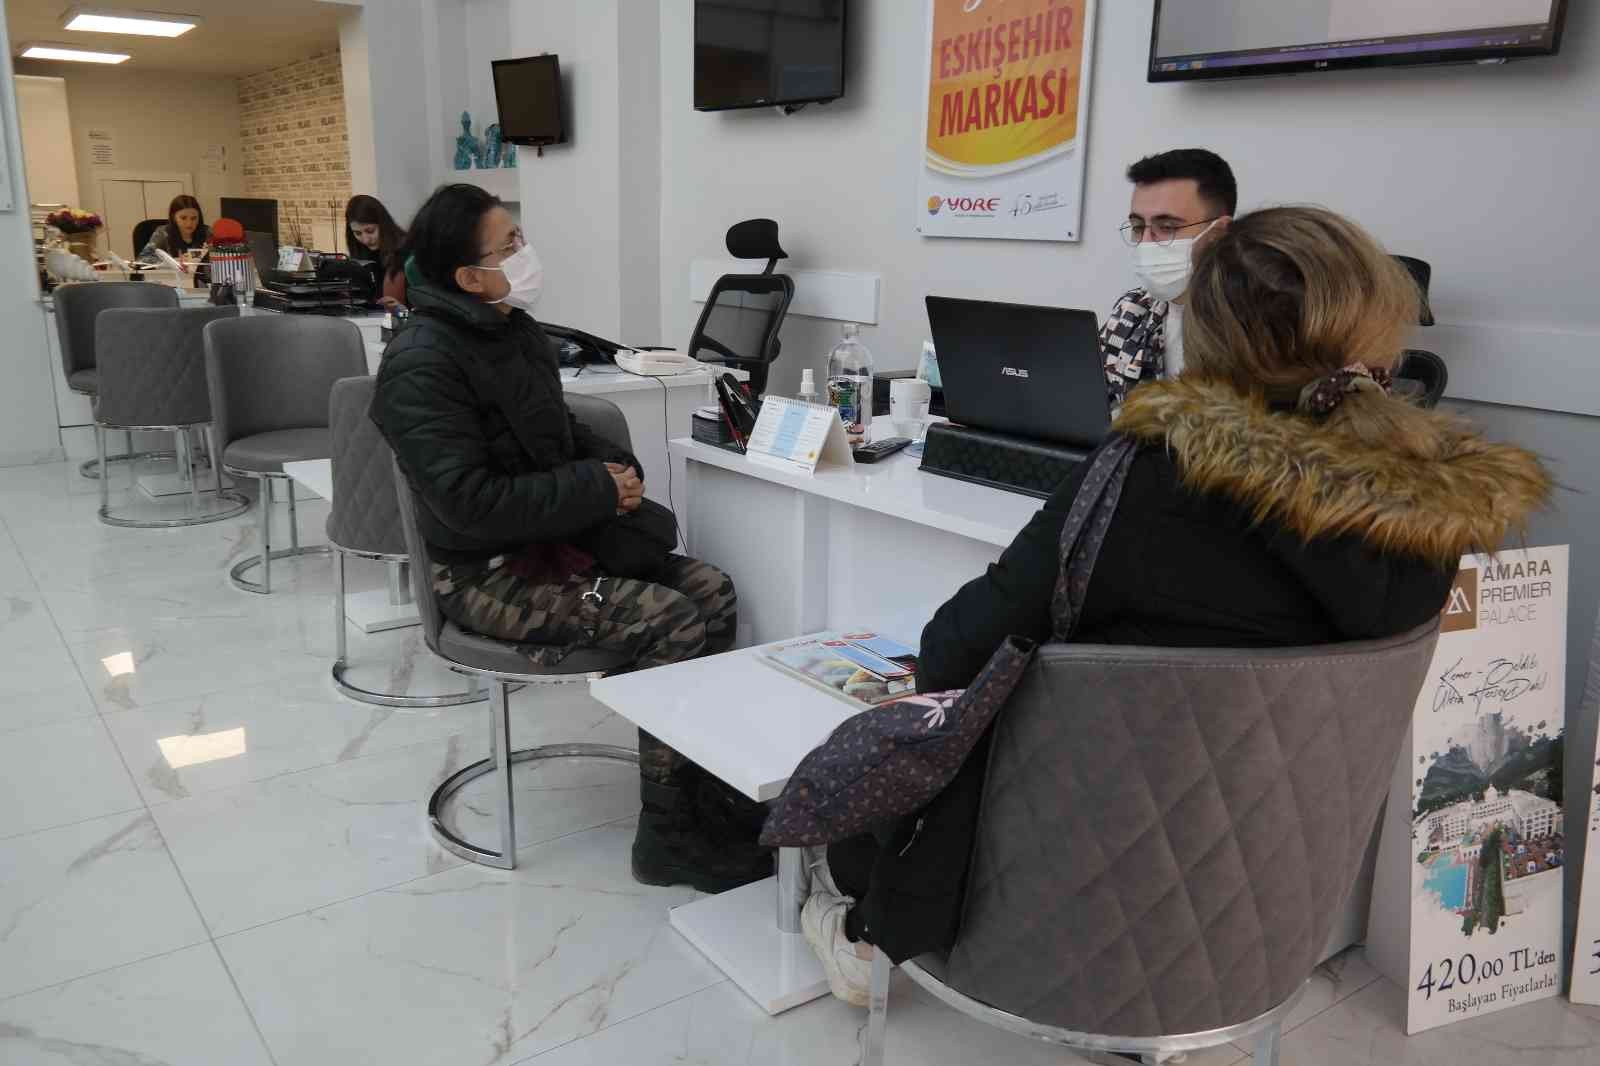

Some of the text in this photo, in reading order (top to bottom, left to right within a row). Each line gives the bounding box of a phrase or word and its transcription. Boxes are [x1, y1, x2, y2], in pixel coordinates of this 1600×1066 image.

[939, 0, 1073, 78] ESKİŞEHİR
[938, 67, 1068, 137] MARKASI
[1002, 366, 1029, 378] ASUS
[1481, 559, 1552, 583] AMARA
[1480, 581, 1552, 605] PREMIER
[1480, 603, 1537, 625] PALACE
[1416, 947, 1556, 1001] 420,00 TL'den
[1448, 974, 1558, 1014] Başlayan Fiyatlarla!
